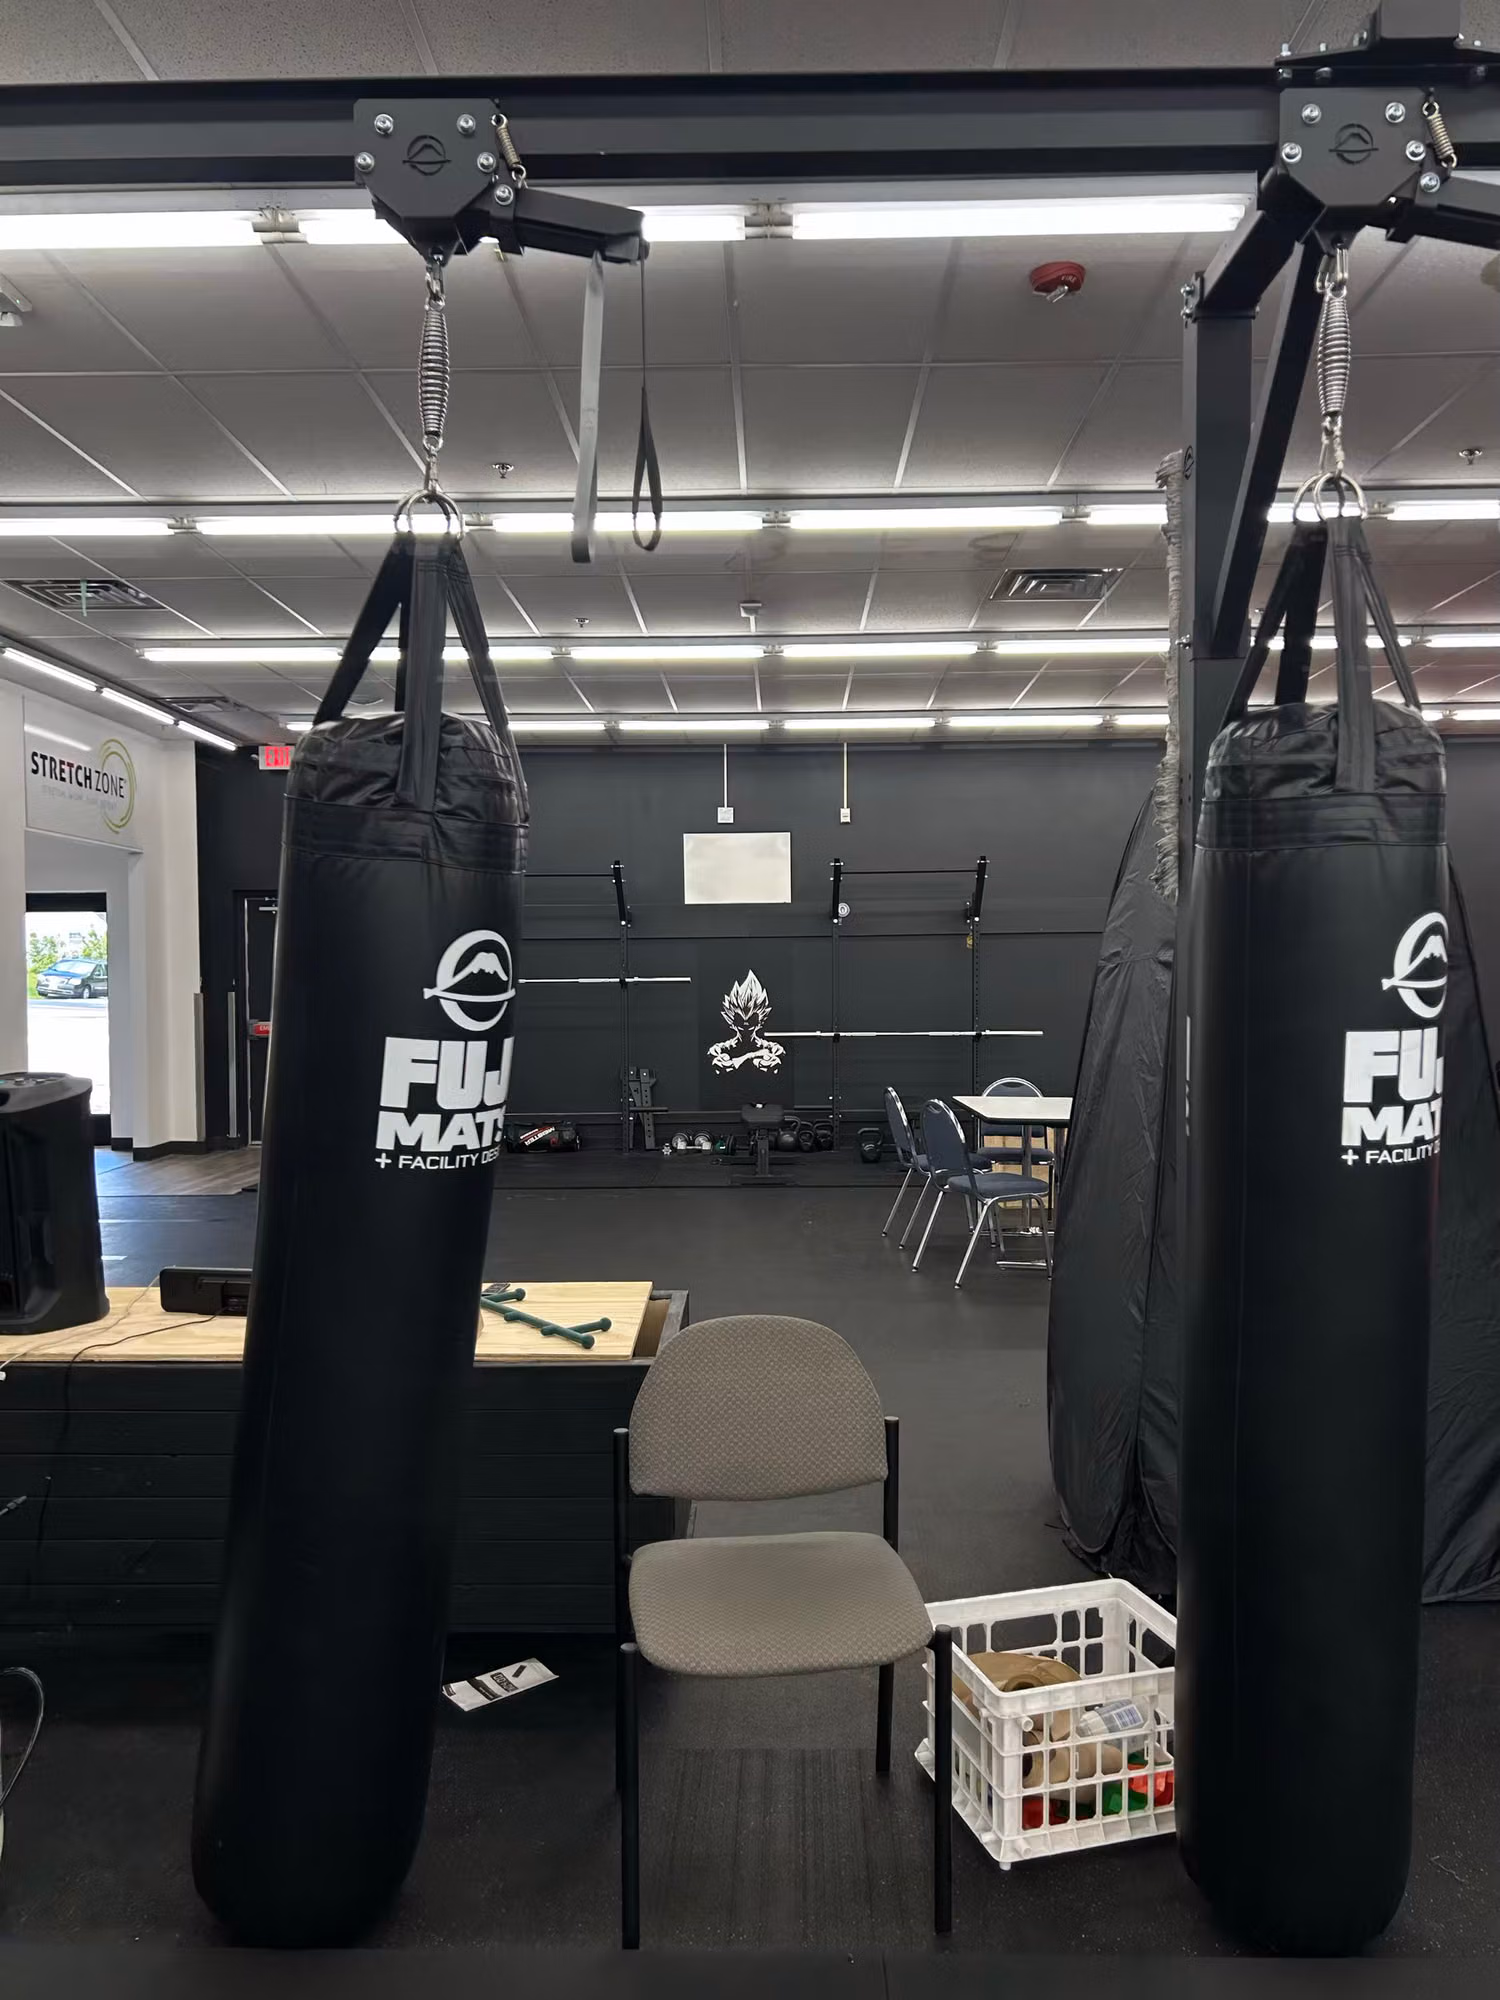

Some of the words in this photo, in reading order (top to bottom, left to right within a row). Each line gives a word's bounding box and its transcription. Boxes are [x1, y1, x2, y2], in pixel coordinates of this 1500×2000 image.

[264, 746, 291, 767] EXIT
[30, 751, 92, 790] STRETCH
[94, 769, 125, 799] ZONE
[398, 1153, 480, 1170] FACILITY
[1365, 1143, 1433, 1165] FACILITY
